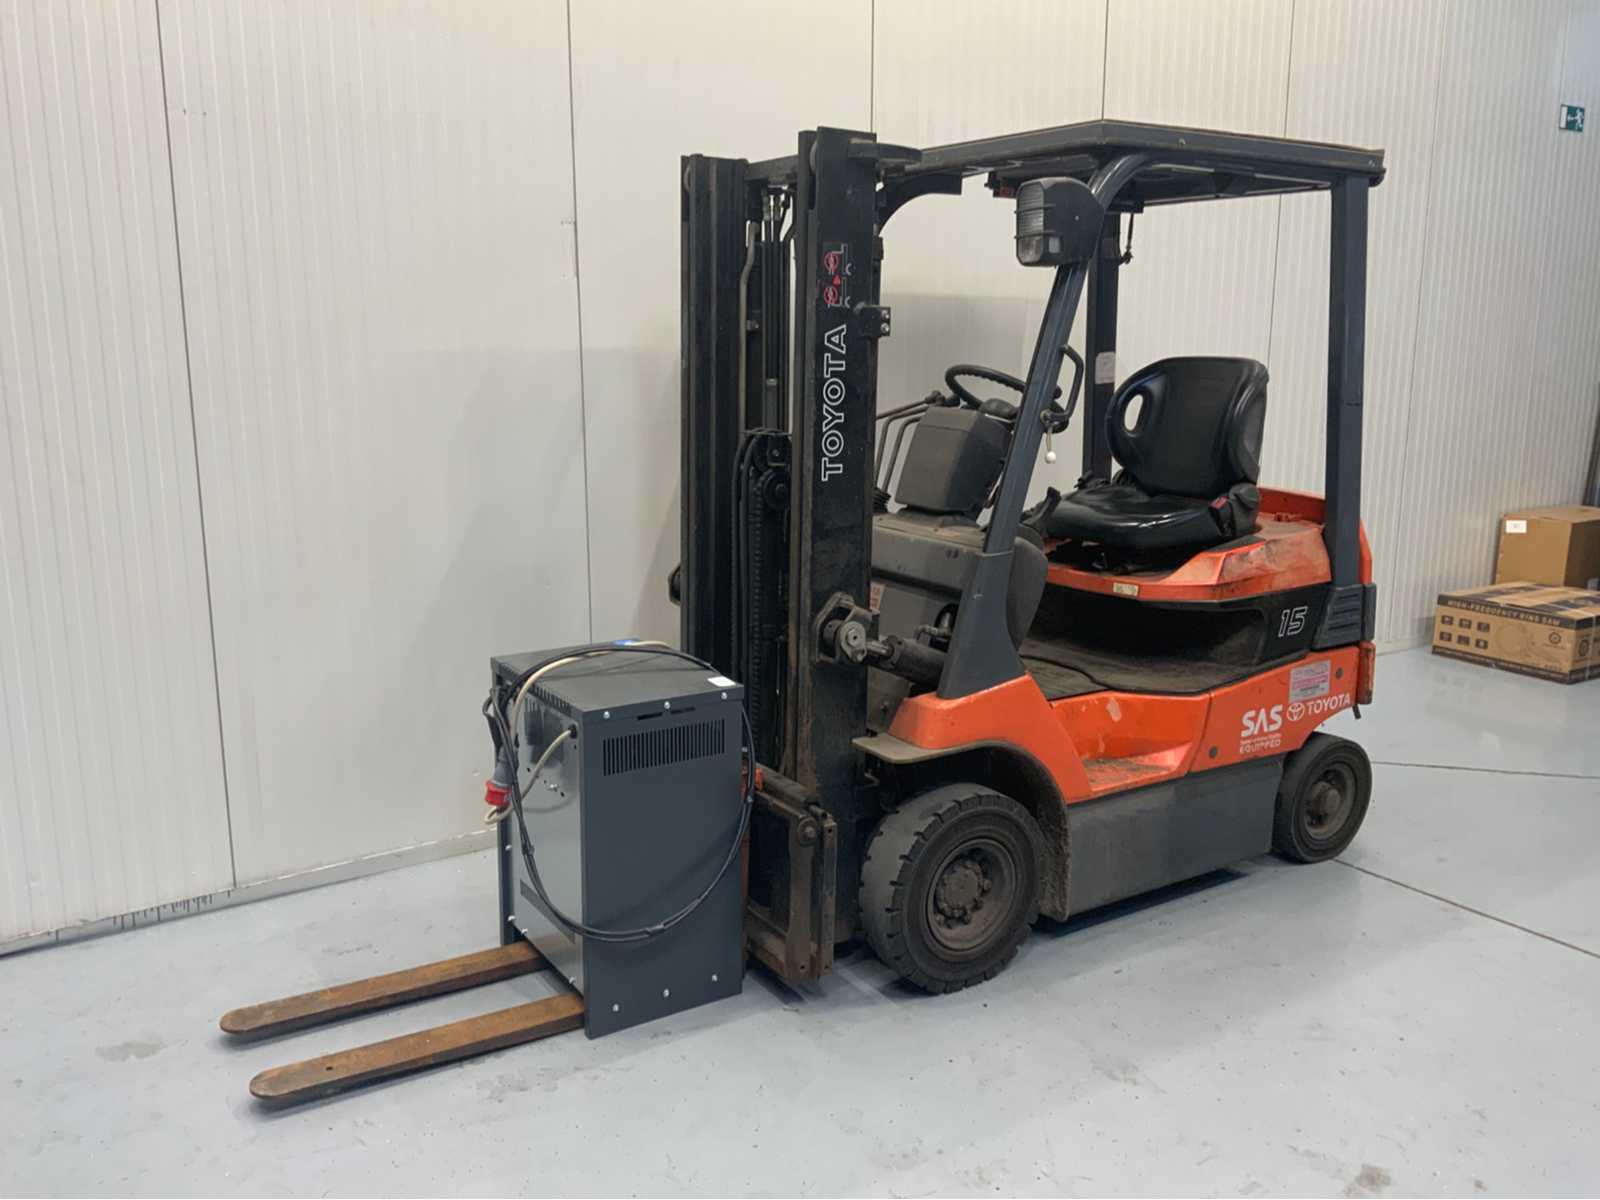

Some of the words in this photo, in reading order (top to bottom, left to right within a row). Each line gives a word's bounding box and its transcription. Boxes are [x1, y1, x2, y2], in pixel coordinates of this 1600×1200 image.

[821, 324, 847, 481] TOYOTA
[1278, 605, 1308, 637] 15
[1241, 704, 1283, 736] SAS
[1307, 693, 1351, 715] TOYOTA
[1239, 738, 1281, 754] EQUIPPED
